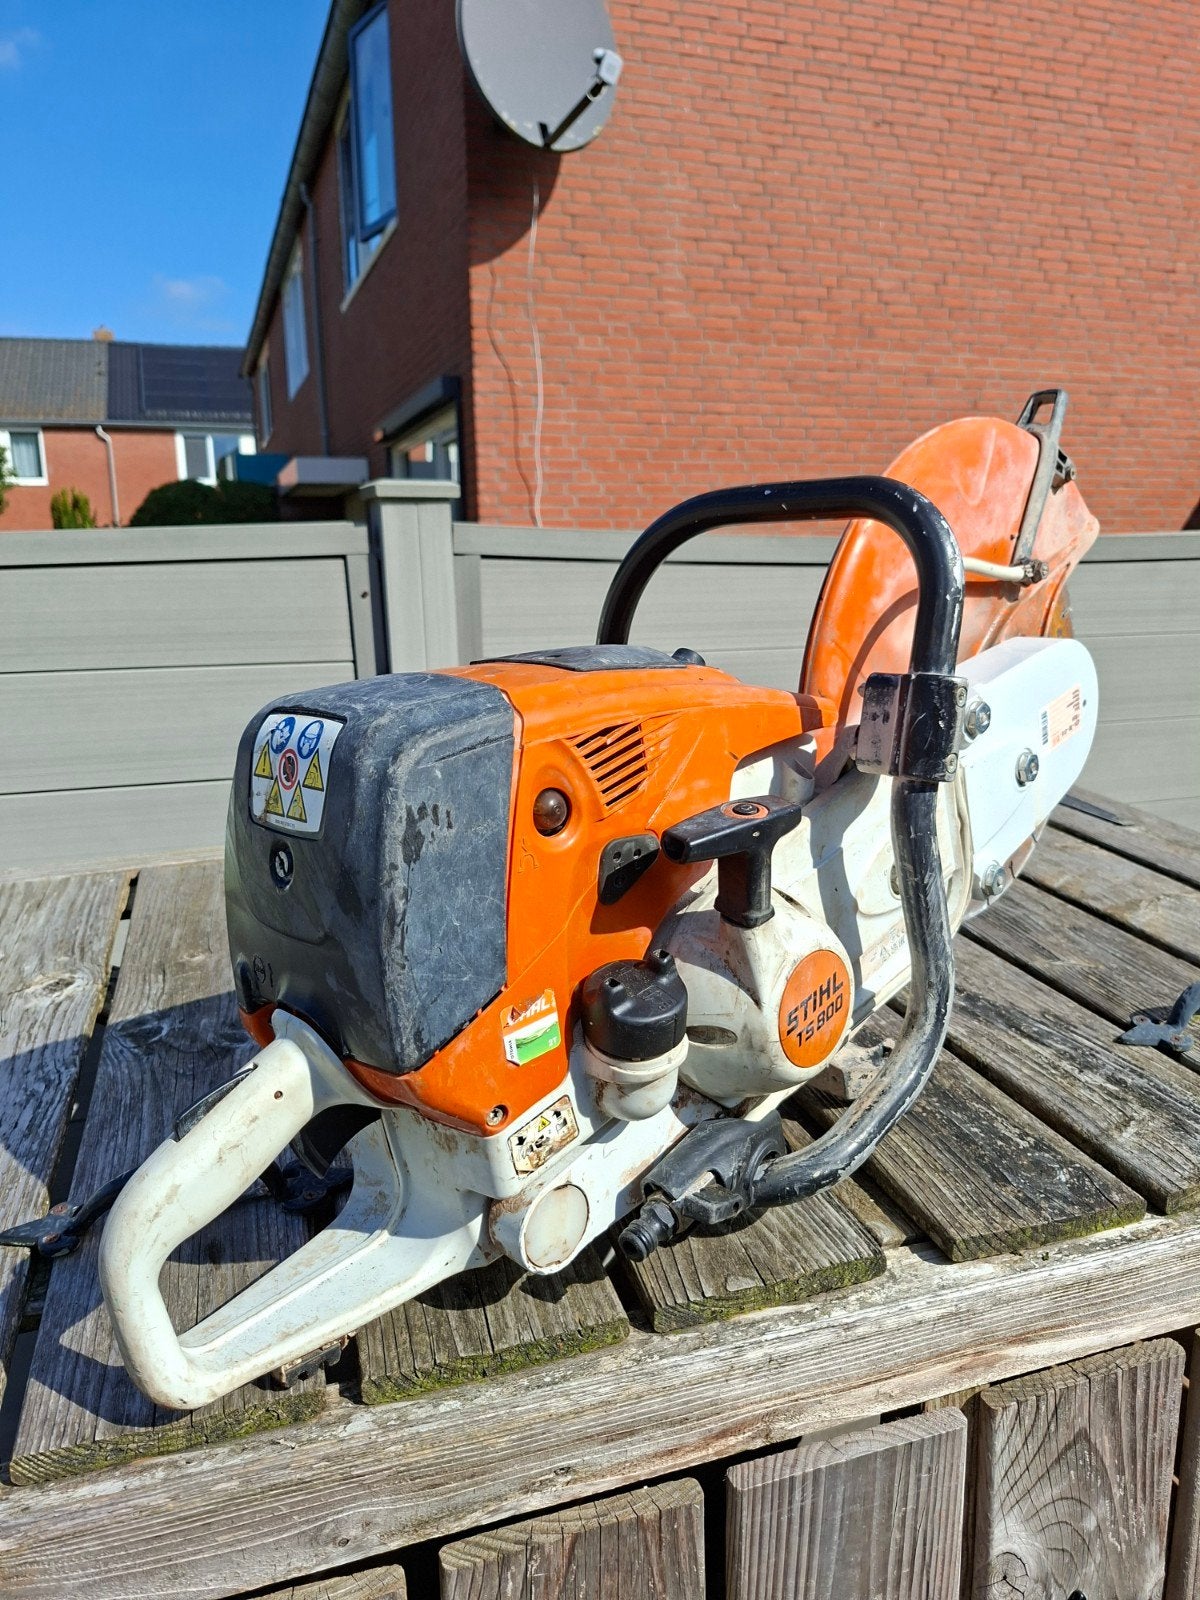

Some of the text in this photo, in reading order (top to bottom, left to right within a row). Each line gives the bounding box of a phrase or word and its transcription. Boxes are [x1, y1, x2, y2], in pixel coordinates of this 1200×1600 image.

[786, 971, 844, 1036] STIHL
[796, 993, 843, 1047] TS 800
